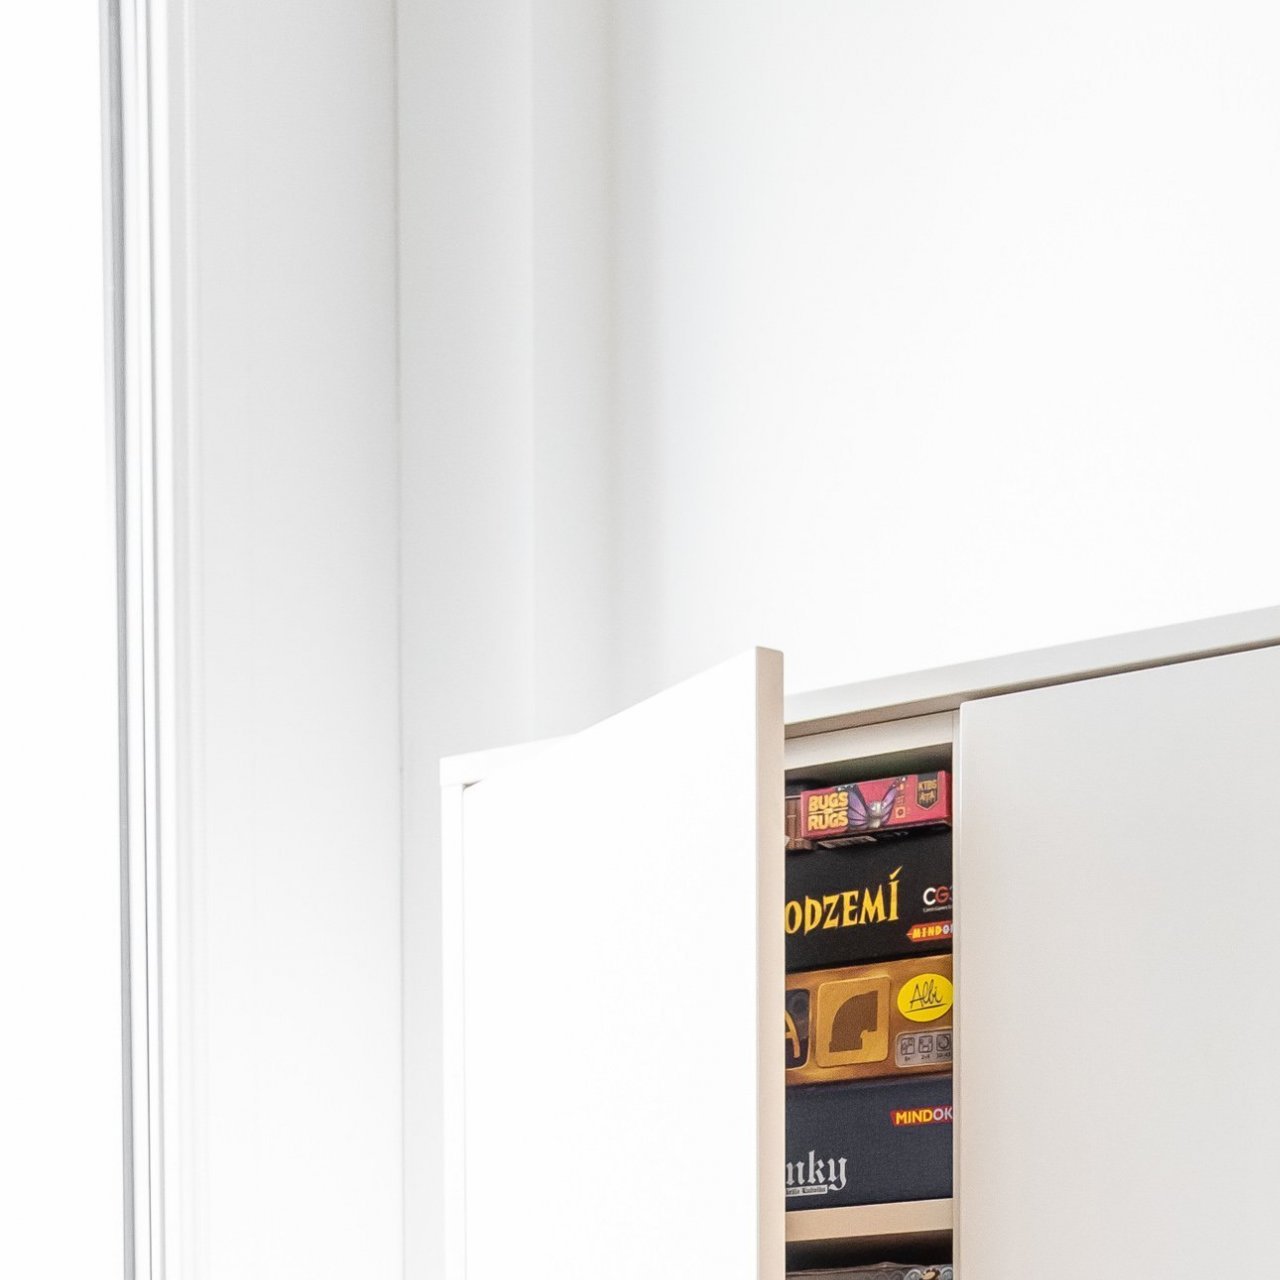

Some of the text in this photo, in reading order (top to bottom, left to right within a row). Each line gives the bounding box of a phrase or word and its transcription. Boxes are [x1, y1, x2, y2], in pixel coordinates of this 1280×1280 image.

[809, 791, 848, 812] BUGS
[808, 810, 848, 831] RUGS
[923, 885, 952, 905] CG
[912, 924, 953, 938] MINDO
[910, 979, 944, 1009] Albi
[895, 1107, 952, 1126] MINDOK
